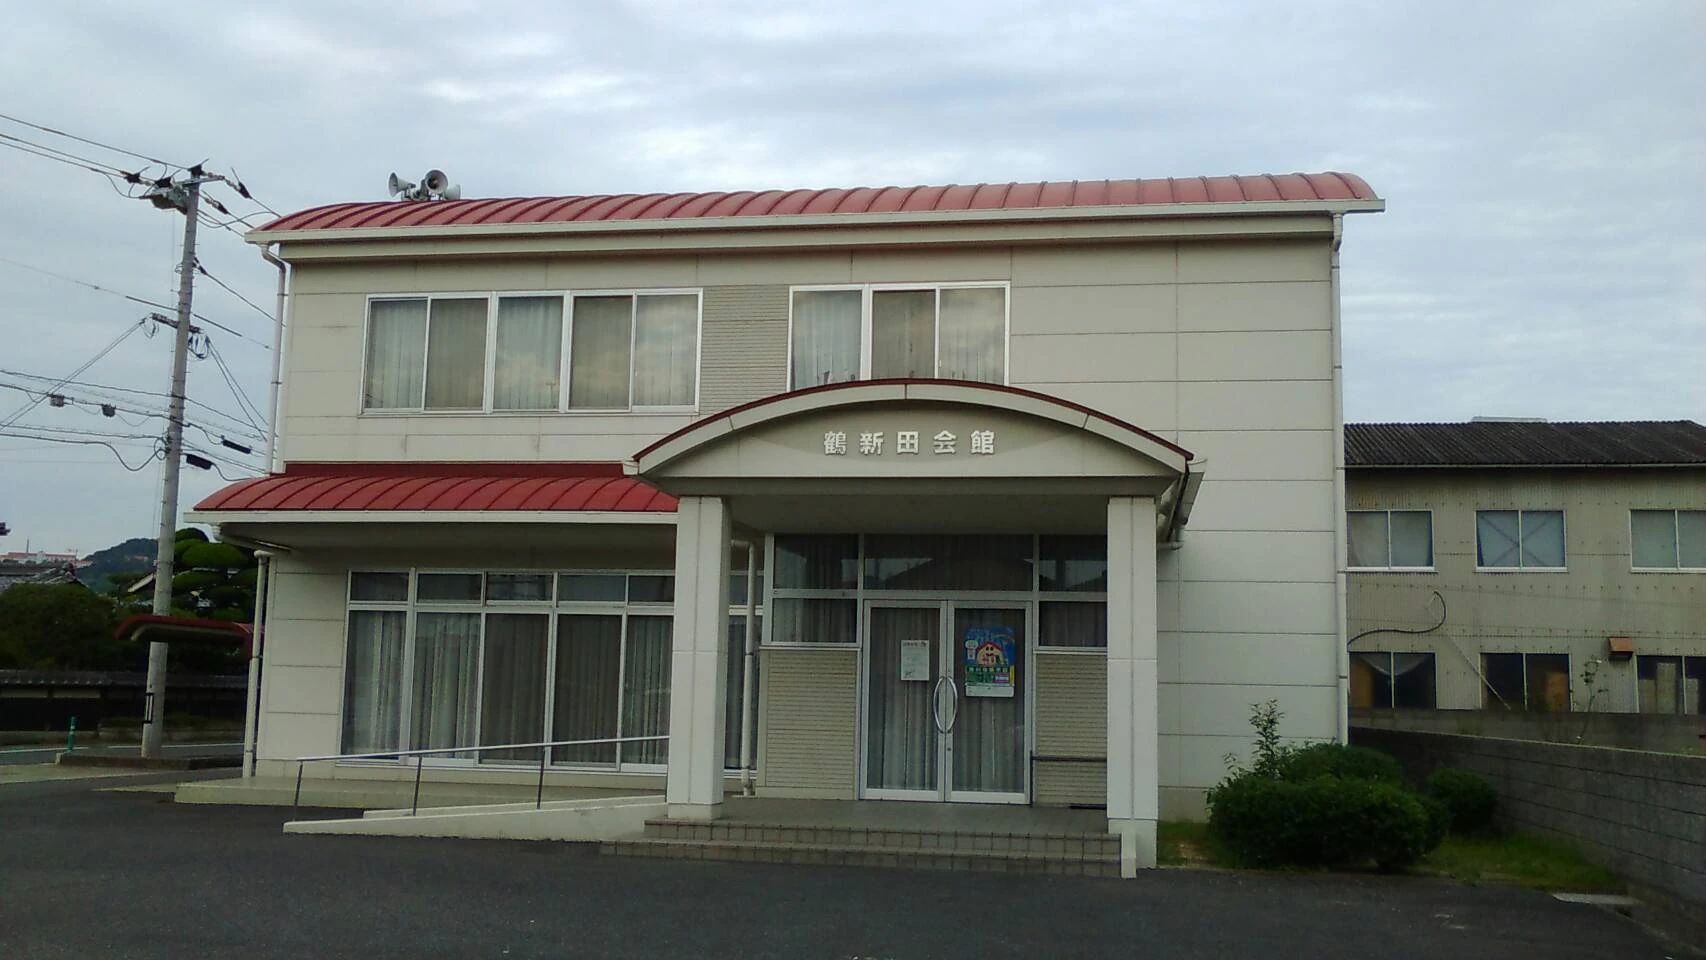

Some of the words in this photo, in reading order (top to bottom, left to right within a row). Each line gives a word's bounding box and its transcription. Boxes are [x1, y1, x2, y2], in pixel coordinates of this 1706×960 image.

[823, 430, 995, 455] 鶴新田会館
